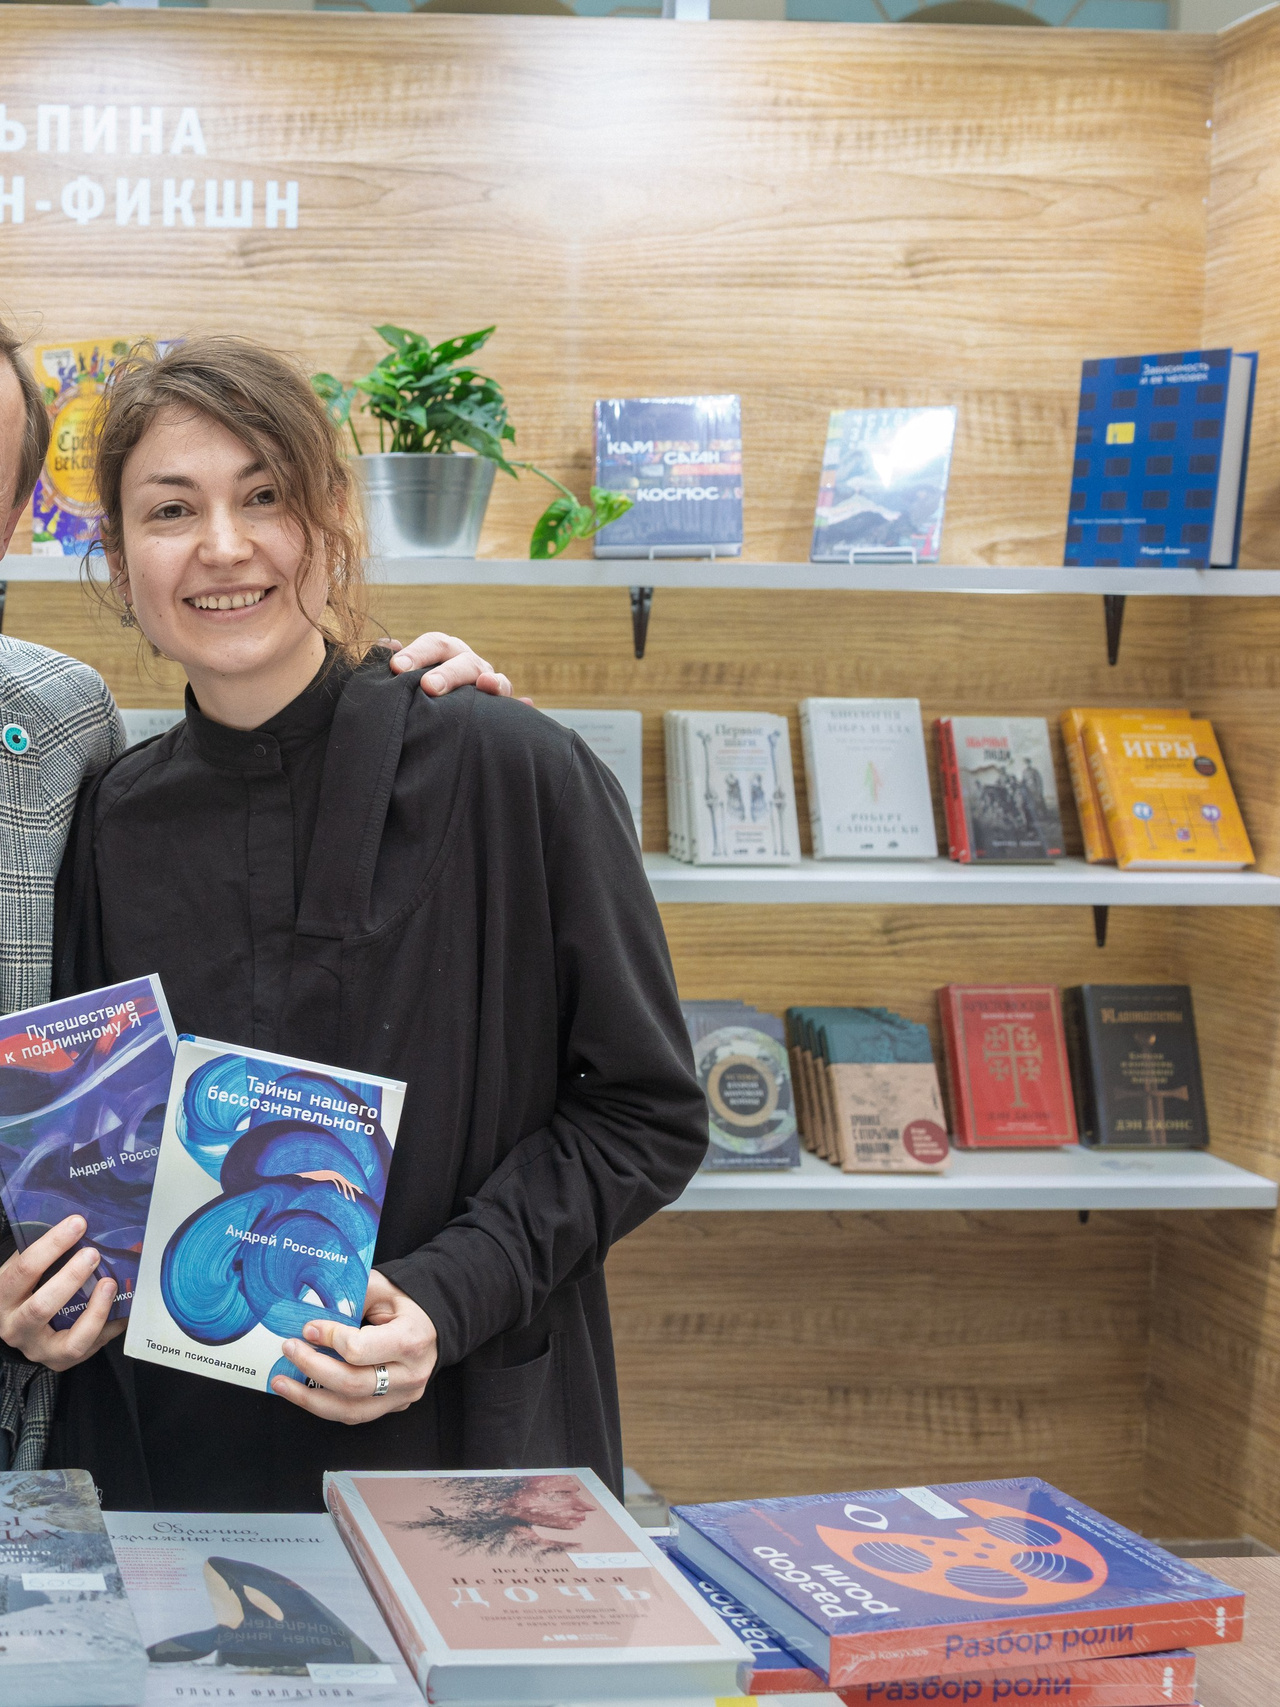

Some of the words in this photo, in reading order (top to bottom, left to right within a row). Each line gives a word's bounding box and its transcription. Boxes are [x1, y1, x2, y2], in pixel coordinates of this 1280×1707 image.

[663, 451, 720, 466] САГАН
[636, 486, 720, 502] КОСМОС
[1122, 739, 1199, 759] ИГРЫ
[26, 1000, 136, 1041] Путешествие
[4, 1051, 17, 1065] к
[21, 1024, 121, 1062] подлинному
[127, 1012, 142, 1028] Я
[207, 1084, 375, 1136] бессознательного
[246, 1075, 302, 1103] Тайны
[309, 1093, 378, 1119] нашего
[1114, 1119, 1143, 1131] ДЭН
[69, 1156, 116, 1179] Андрей
[119, 1145, 160, 1165] Россо
[225, 1223, 277, 1247] Андрей
[282, 1237, 348, 1264] Россохин
[146, 1338, 181, 1356] Теория
[184, 1350, 257, 1377] психоанализа
[153, 1521, 260, 1536] Облачно,
[221, 1536, 325, 1544] косатки
[451, 1576, 625, 1586] Нелюбимая
[524, 1566, 569, 1575] Стрип
[753, 1546, 859, 1618] Разбор
[448, 1585, 651, 1609] ДОЧЬ
[811, 1564, 900, 1615] роли
[19, 1628, 67, 1637] СЛАТ
[945, 1628, 1053, 1660] Разбор
[1062, 1622, 1135, 1648] роли
[176, 1686, 236, 1698] ОЛЬГА
[251, 1687, 355, 1699] ФИЛАТОВА
[866, 1676, 982, 1703] Разбор
[991, 1674, 1072, 1701] роли
